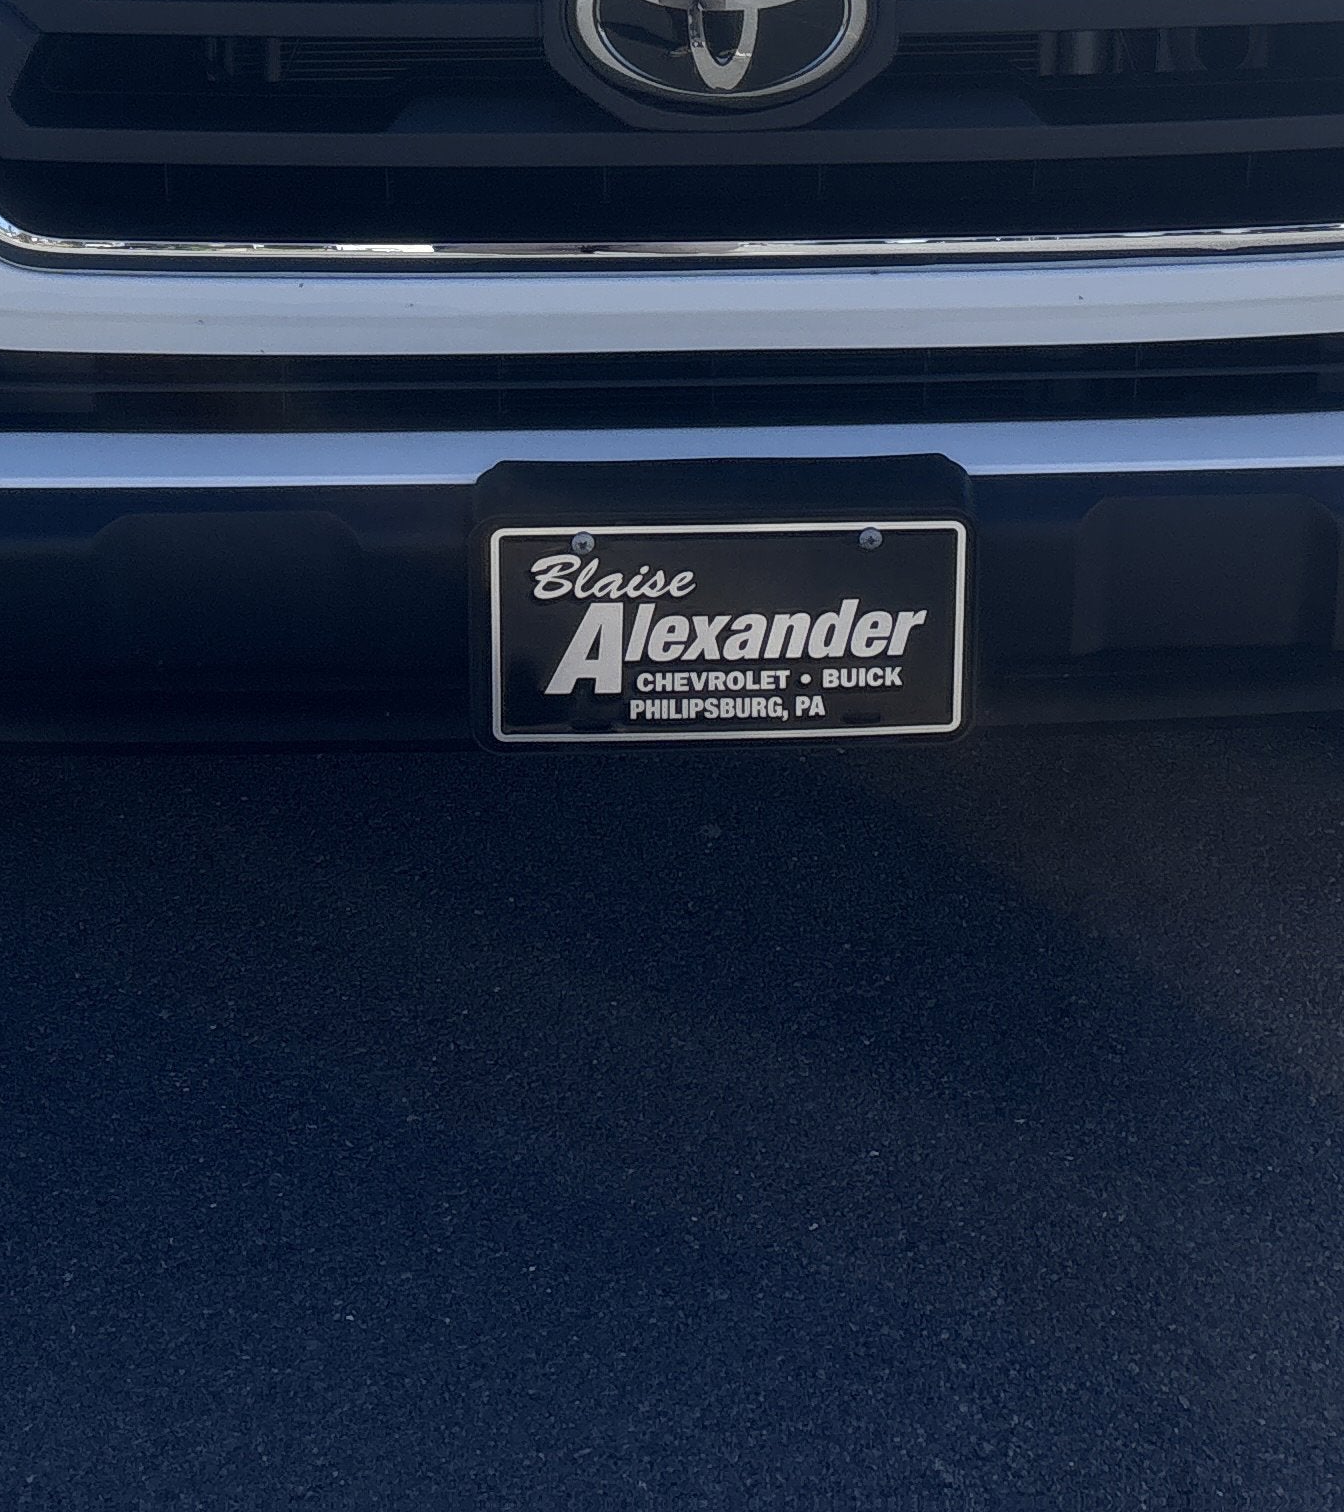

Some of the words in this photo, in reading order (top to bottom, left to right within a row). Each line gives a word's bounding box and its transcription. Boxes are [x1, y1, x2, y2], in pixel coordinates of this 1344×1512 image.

[530, 553, 697, 599] Blaise
[544, 598, 928, 695] Alexander
[636, 669, 791, 693] CHEVROLET
[821, 666, 904, 689] BUICK
[629, 696, 789, 722] PHILIPSBURG,
[794, 695, 827, 718] PA
